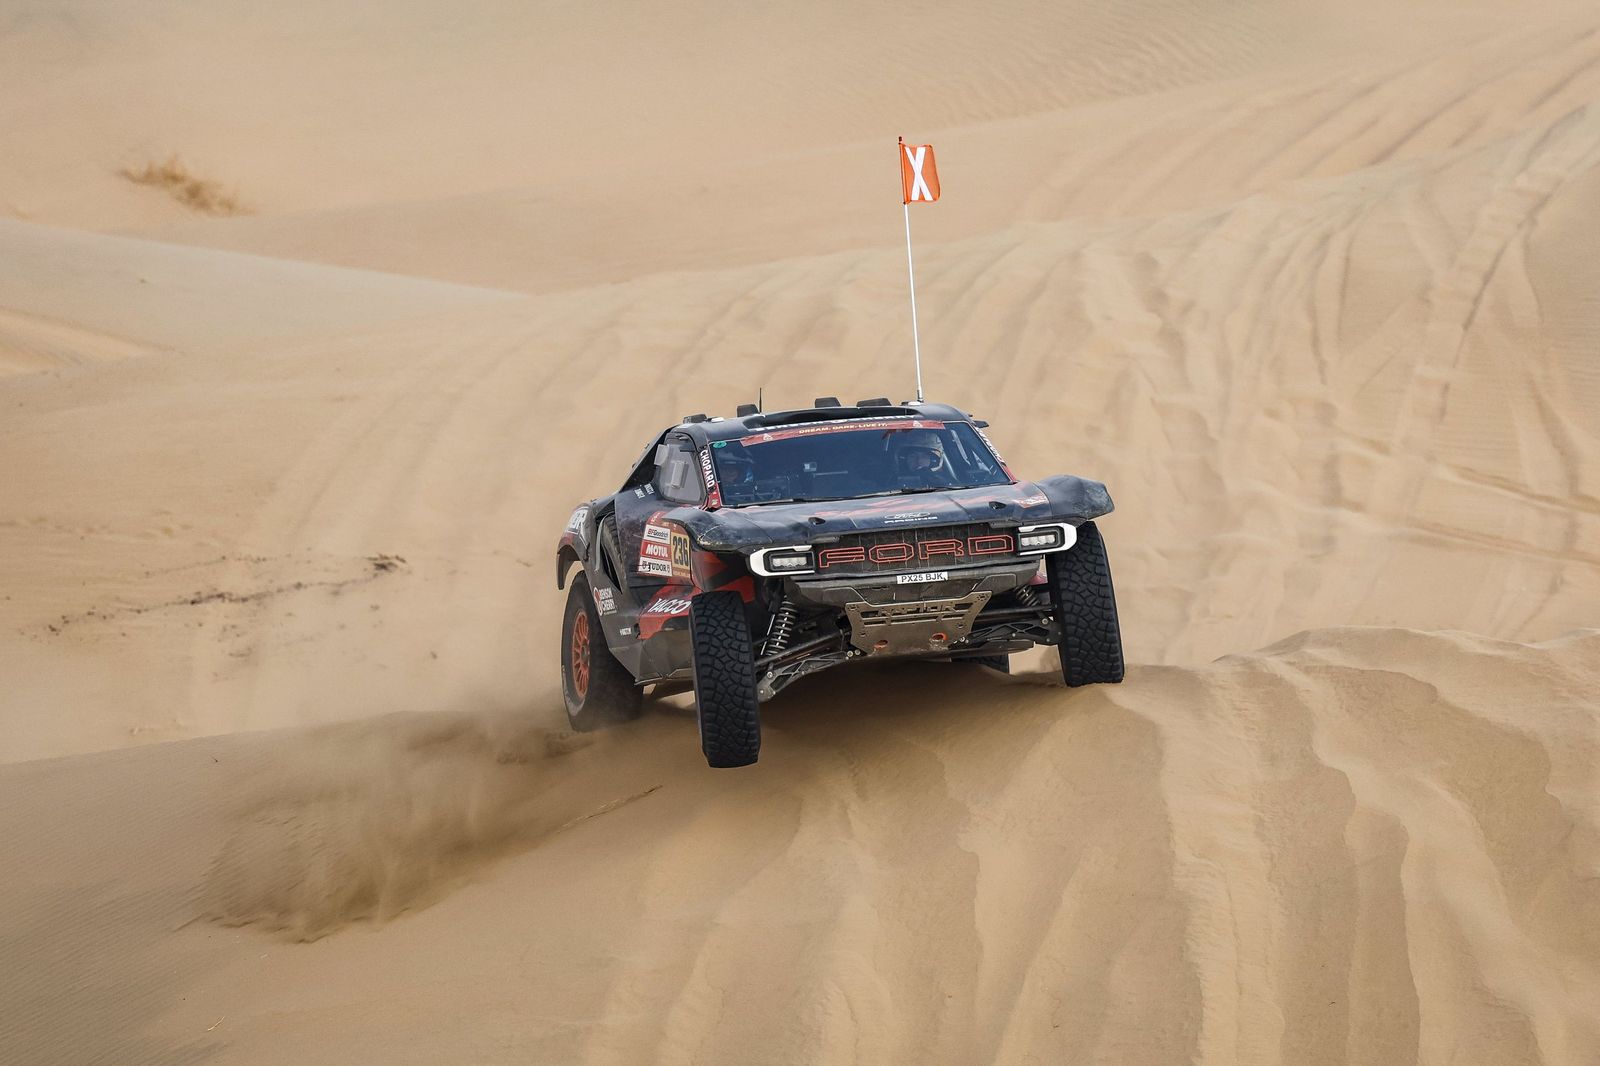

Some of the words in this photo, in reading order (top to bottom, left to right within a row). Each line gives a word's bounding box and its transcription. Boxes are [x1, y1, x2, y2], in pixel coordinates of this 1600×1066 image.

[700, 449, 715, 488] CHOPARD
[647, 528, 668, 538] BFGoodrich
[645, 543, 669, 557] MOTUL
[672, 535, 689, 566] 236
[819, 535, 1014, 568] FORD
[648, 561, 668, 572] TUDOR
[901, 573, 924, 583] PX25
[925, 572, 943, 581] BJK
[647, 598, 692, 615] YACCO
